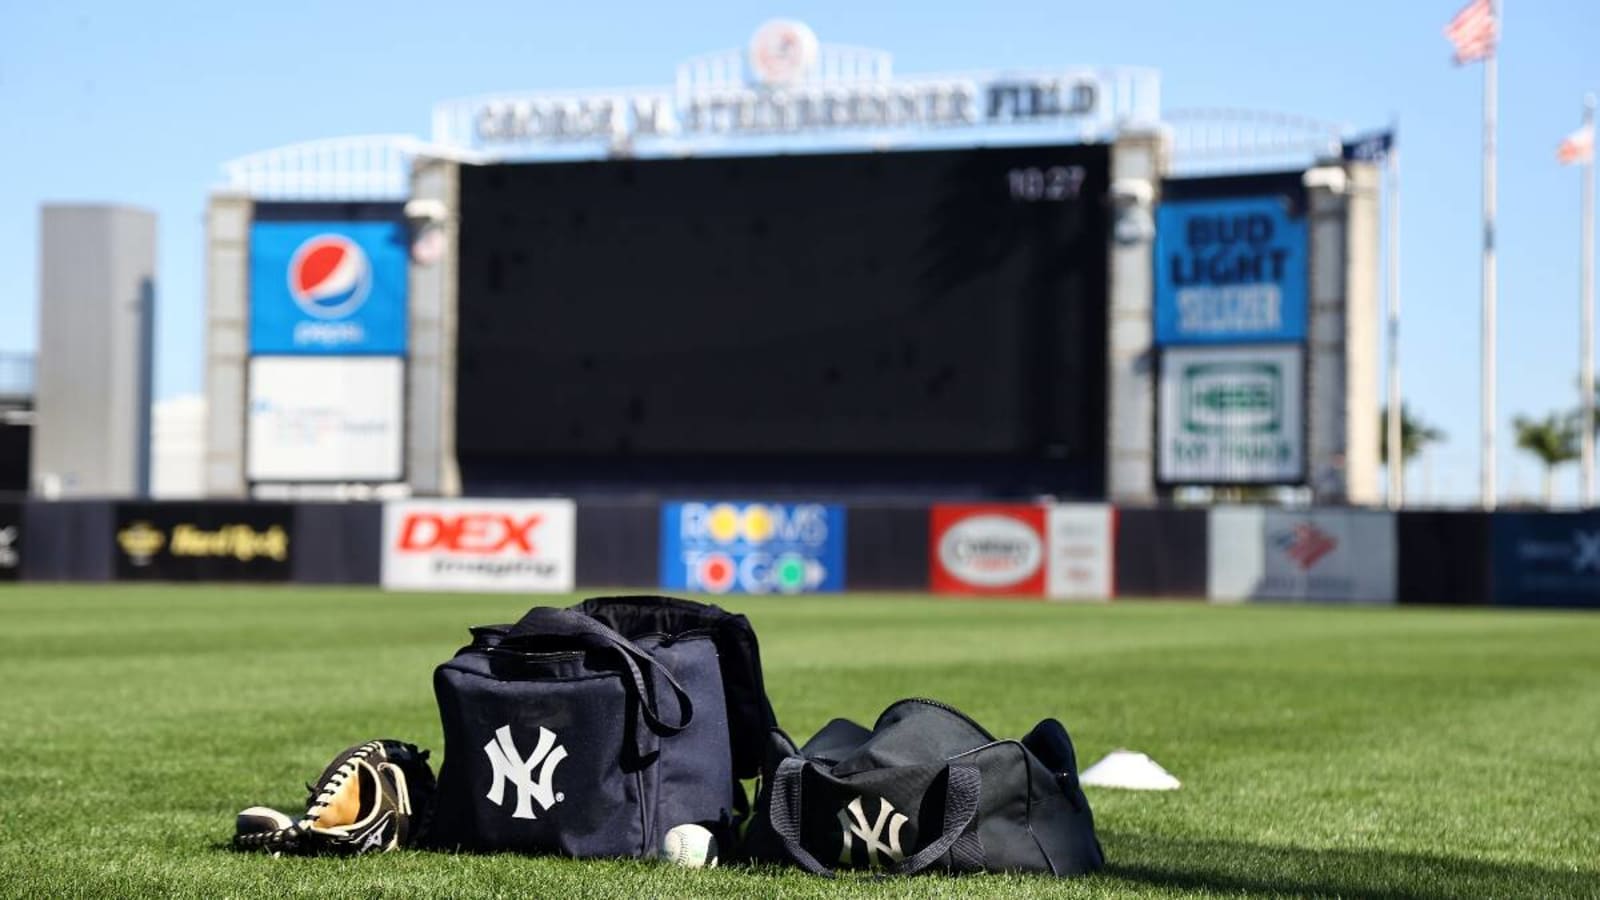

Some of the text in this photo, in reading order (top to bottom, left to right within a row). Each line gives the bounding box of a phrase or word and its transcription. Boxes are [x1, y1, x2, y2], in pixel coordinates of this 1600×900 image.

[985, 78, 1099, 121] FIELD
[1187, 215, 1273, 247] BUD
[1170, 247, 1290, 286] LIGHT
[397, 512, 541, 555] DEX
[681, 502, 829, 547] ROOMS
